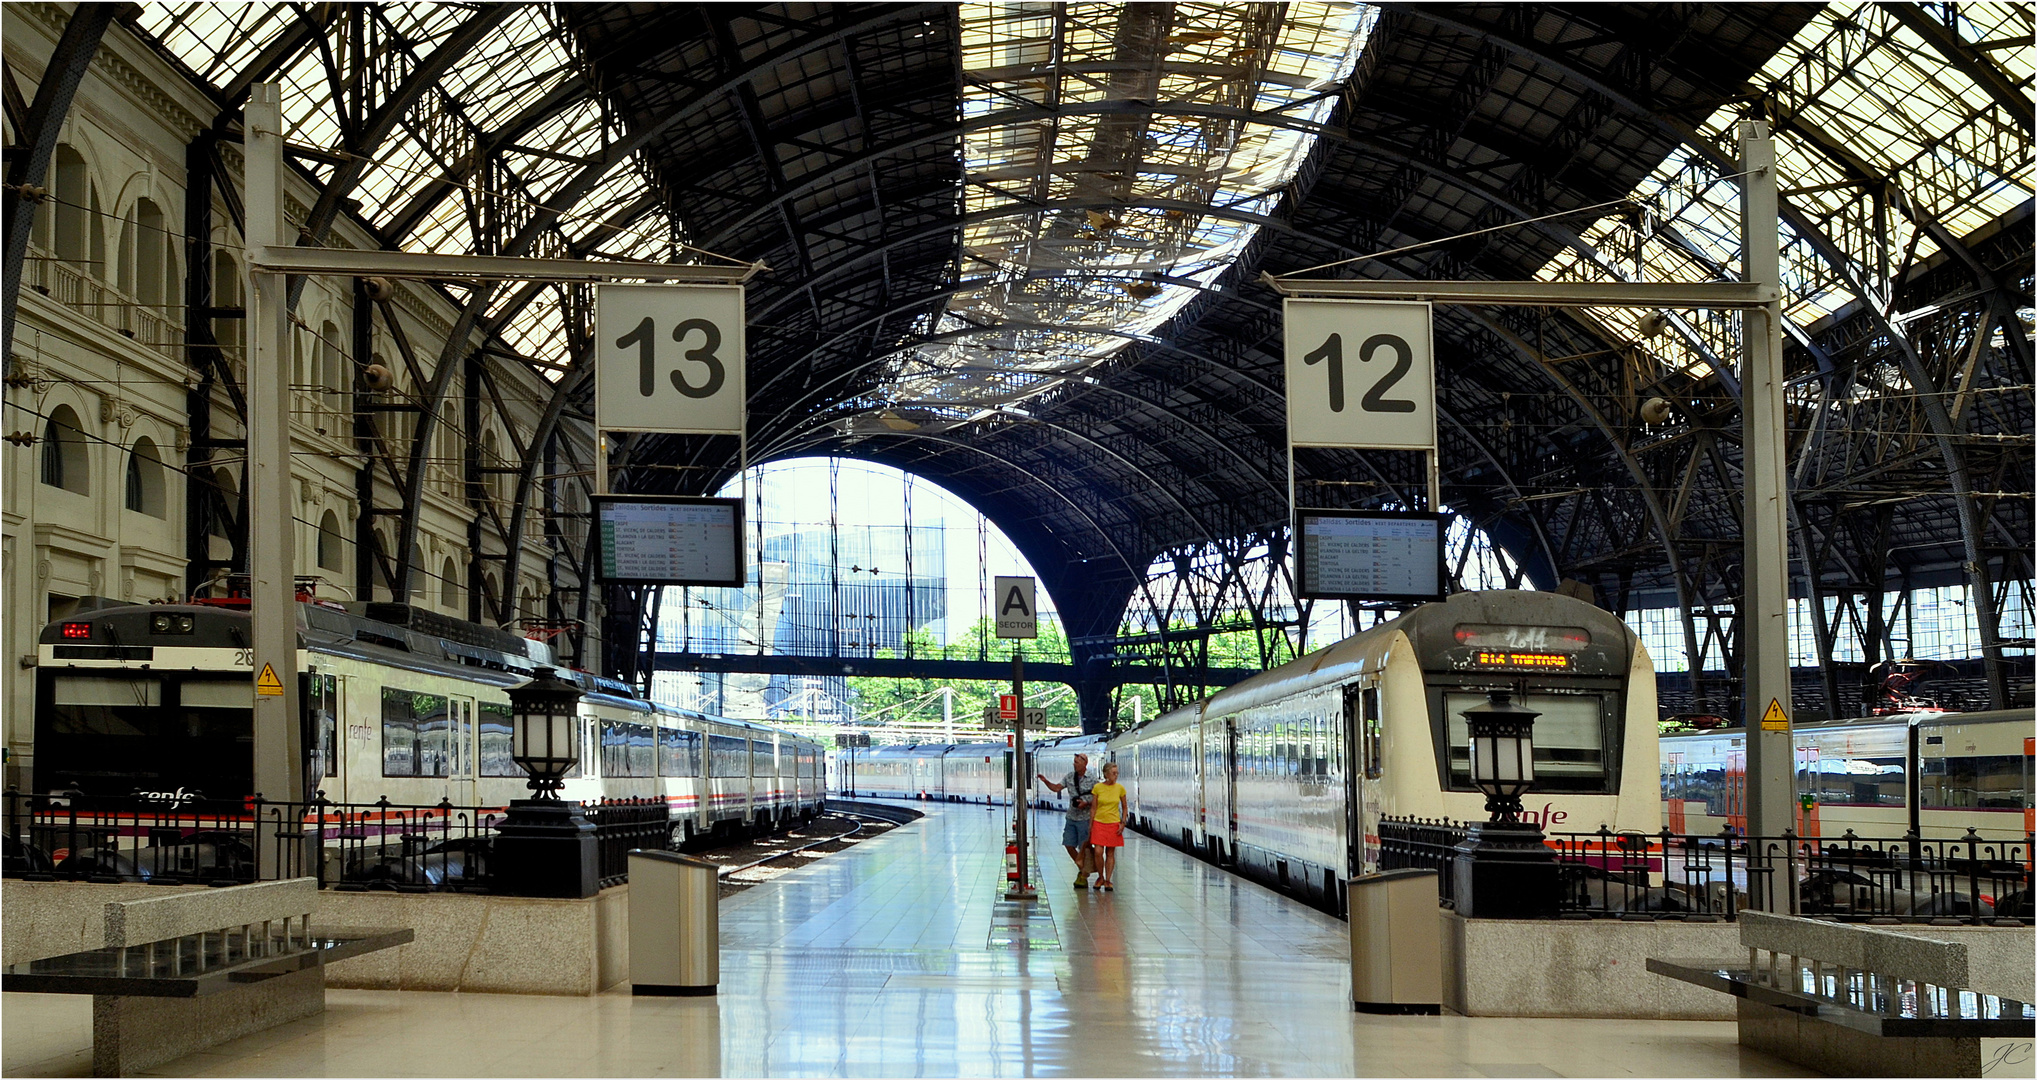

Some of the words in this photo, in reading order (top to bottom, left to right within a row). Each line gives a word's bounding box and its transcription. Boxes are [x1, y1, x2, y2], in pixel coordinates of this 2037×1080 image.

[616, 316, 726, 398] 13
[1304, 332, 1416, 412] 12
[1002, 586, 1030, 616] A
[998, 621, 1033, 629] SECTOR
[1510, 654, 1567, 666] TORTOSA
[986, 712, 1004, 724] 13
[1026, 712, 1044, 724] 12
[349, 716, 372, 749] renfe
[837, 736, 846, 744] 13
[139, 786, 195, 810] renfe
[1492, 802, 1568, 831] nfe
